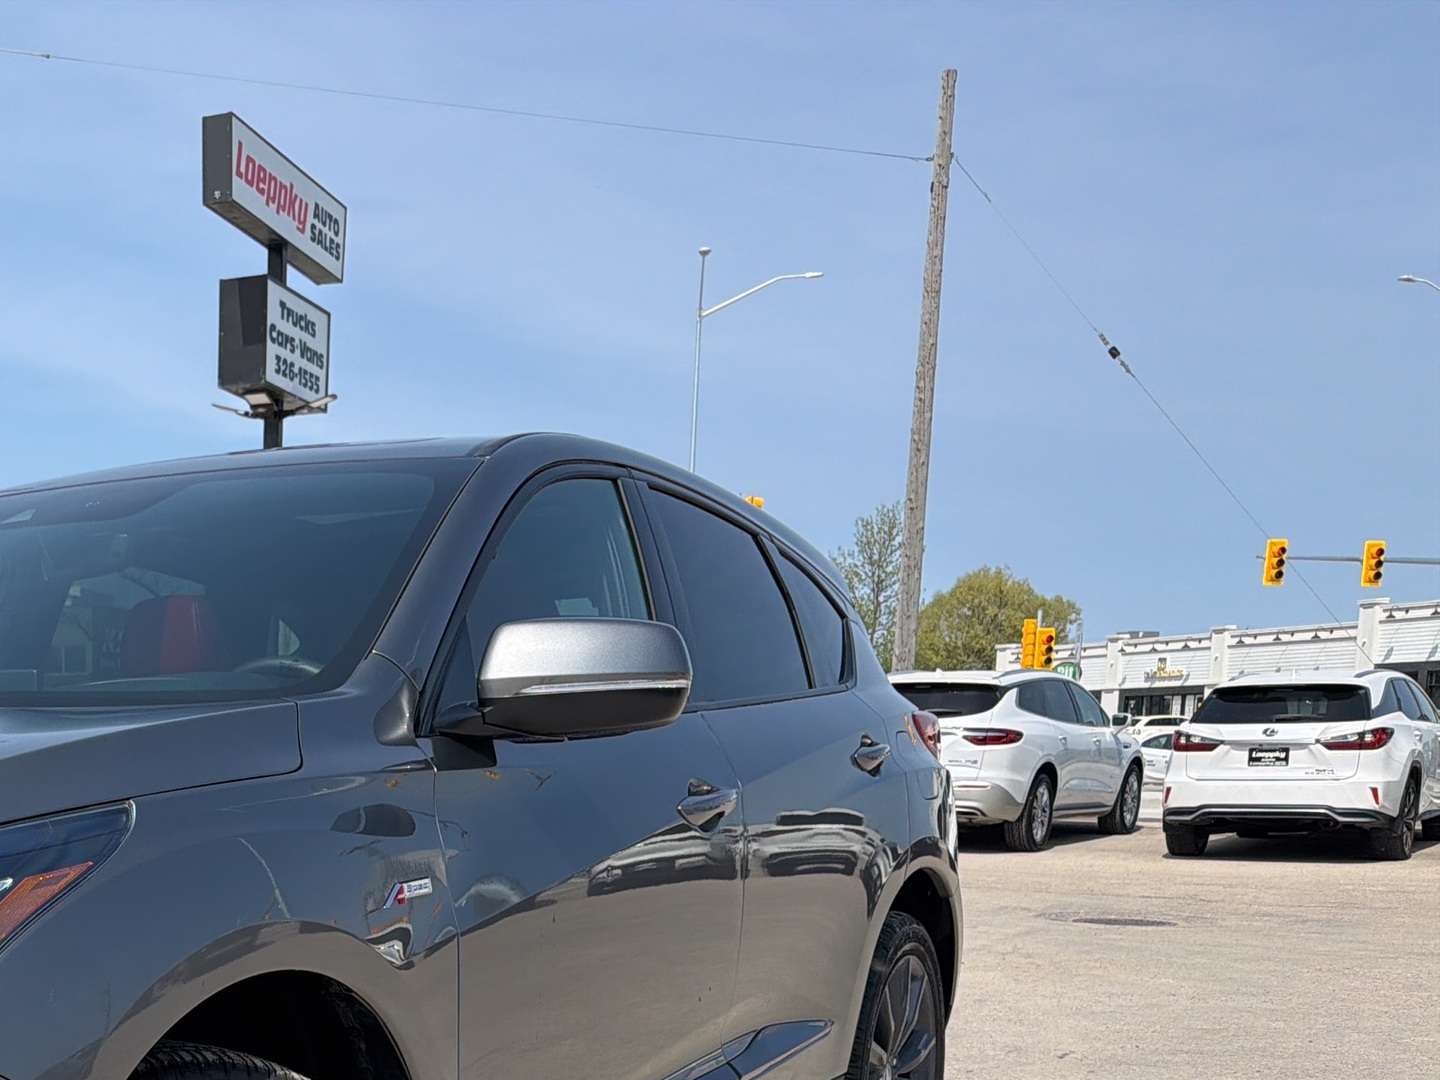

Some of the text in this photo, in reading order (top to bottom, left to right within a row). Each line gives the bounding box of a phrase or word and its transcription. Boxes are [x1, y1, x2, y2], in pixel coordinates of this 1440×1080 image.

[235, 140, 309, 235] Loeppky
[312, 201, 340, 238] AUTO
[309, 223, 341, 262] SALES
[279, 299, 317, 338] Trucks
